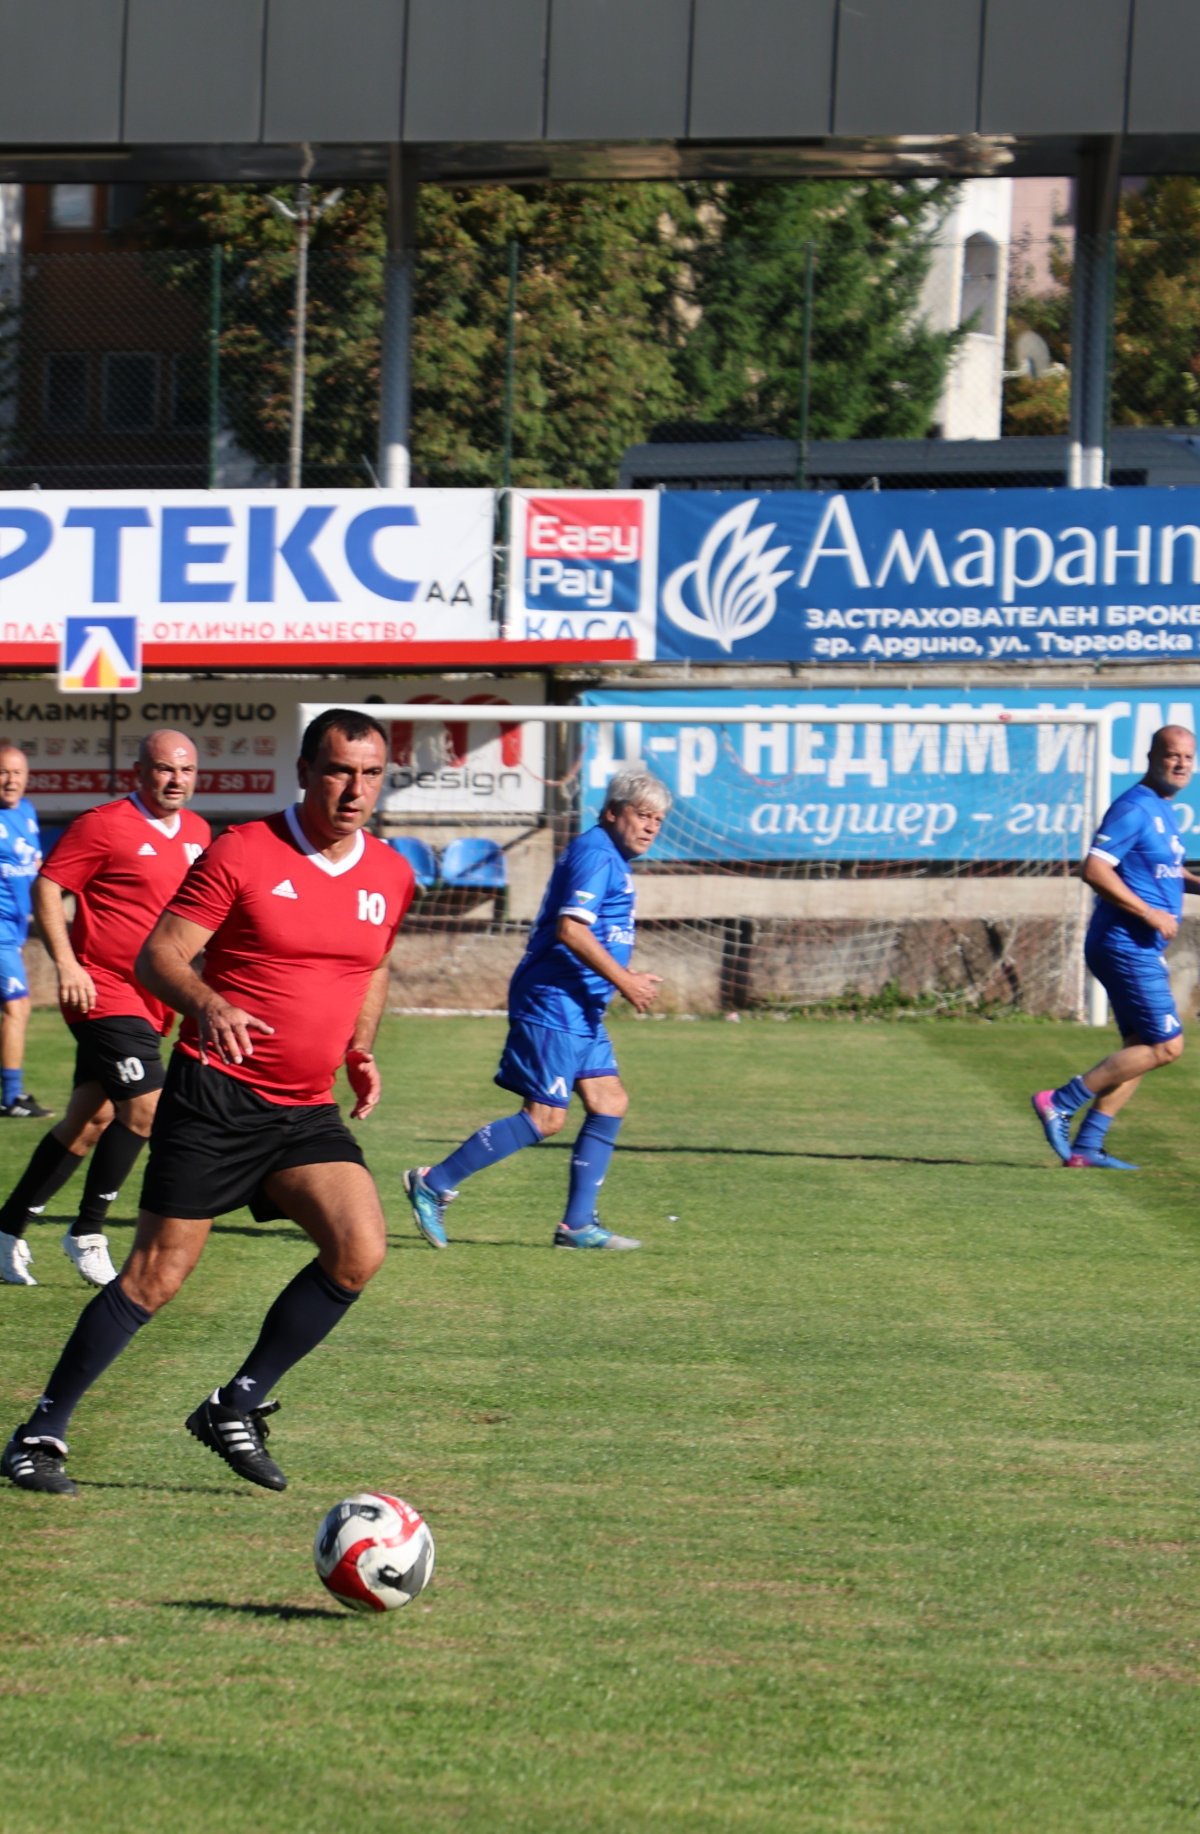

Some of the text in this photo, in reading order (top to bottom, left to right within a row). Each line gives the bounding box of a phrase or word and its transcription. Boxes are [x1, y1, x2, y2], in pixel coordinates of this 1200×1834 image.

[529, 514, 640, 563] Easy
[425, 580, 474, 607] АД
[529, 558, 614, 608] Pay
[525, 615, 634, 640] КАСА
[806, 606, 1099, 630] ЗАСТРАХОВАТЕЛЕН
[152, 621, 276, 643] ОТЛИЧНО
[284, 620, 418, 642] КАЧЕСТВО
[814, 631, 1193, 658] гр. Ардино, ул. Търговска
[141, 703, 276, 728] студио
[743, 704, 1011, 788] НЕДИМ
[1036, 702, 1199, 776] ИСМ
[67, 773, 93, 790] 54
[219, 774, 245, 790] 58
[249, 774, 271, 790] 17
[751, 802, 957, 846] акушер
